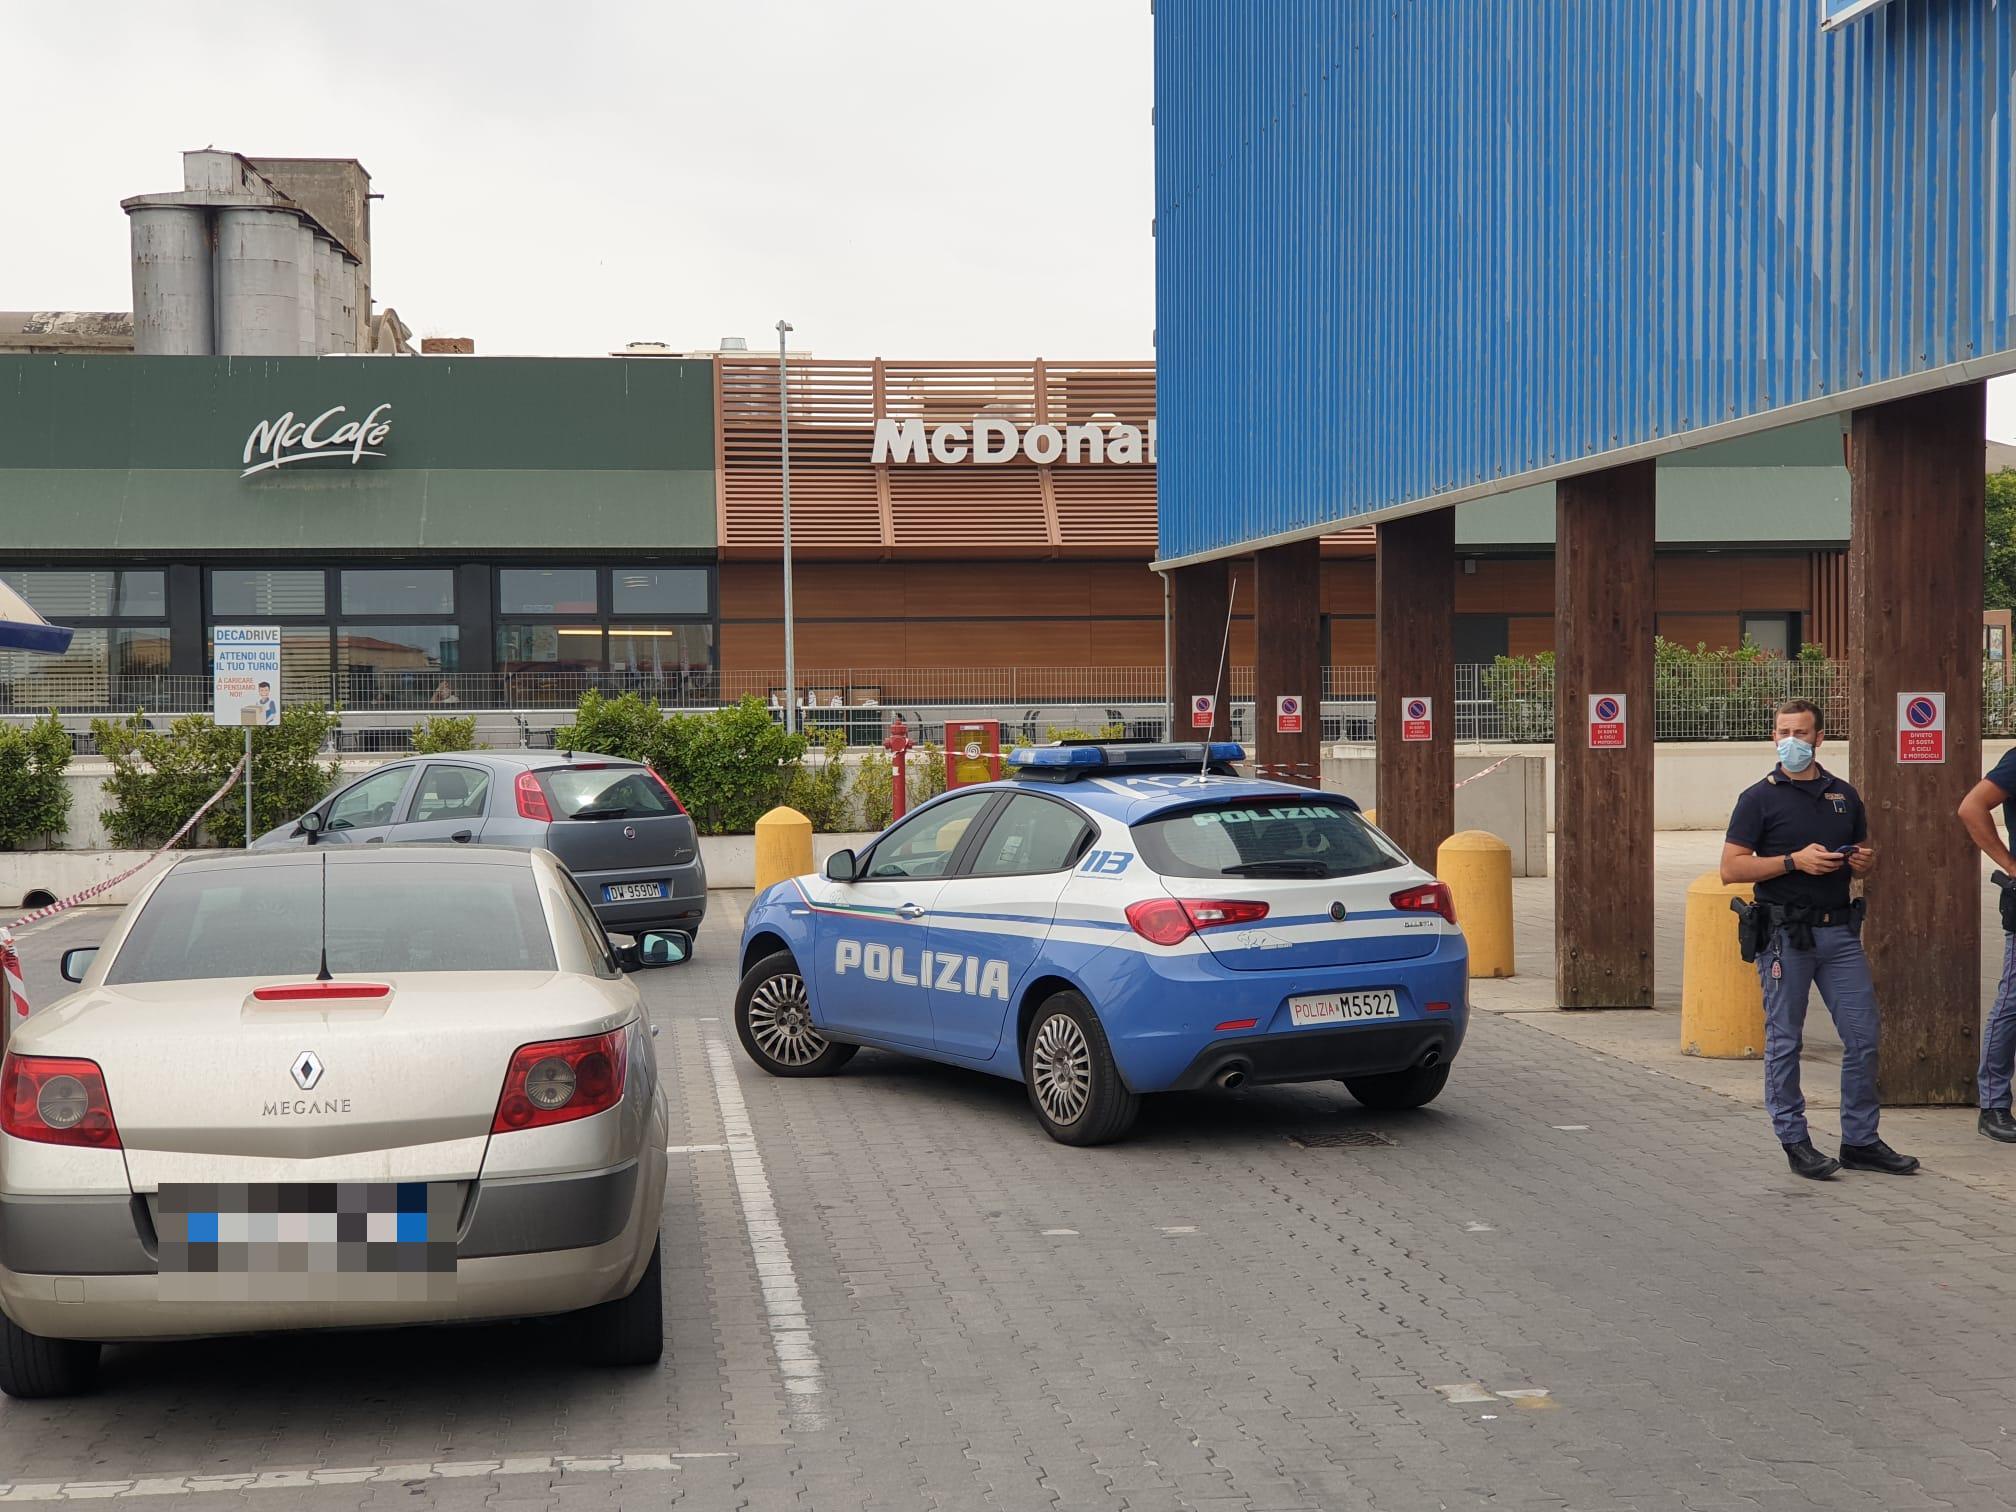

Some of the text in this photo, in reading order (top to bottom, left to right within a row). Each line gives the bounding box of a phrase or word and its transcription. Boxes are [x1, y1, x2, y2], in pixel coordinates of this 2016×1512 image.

[242, 403, 392, 469] McCafé
[871, 418, 1157, 464] McDonal
[216, 630, 278, 641] DECADRIVE
[216, 662, 278, 671] IL TUO TURNO
[220, 651, 275, 661] ATTENDI QUI
[1191, 806, 1341, 827] POLIZIA
[1080, 850, 1135, 875] 113
[627, 883, 660, 898] 959DM
[835, 938, 1010, 1002] POLIZIA
[1295, 993, 1395, 1018] POLIZIA M5522
[262, 1099, 352, 1116] MEGANE
